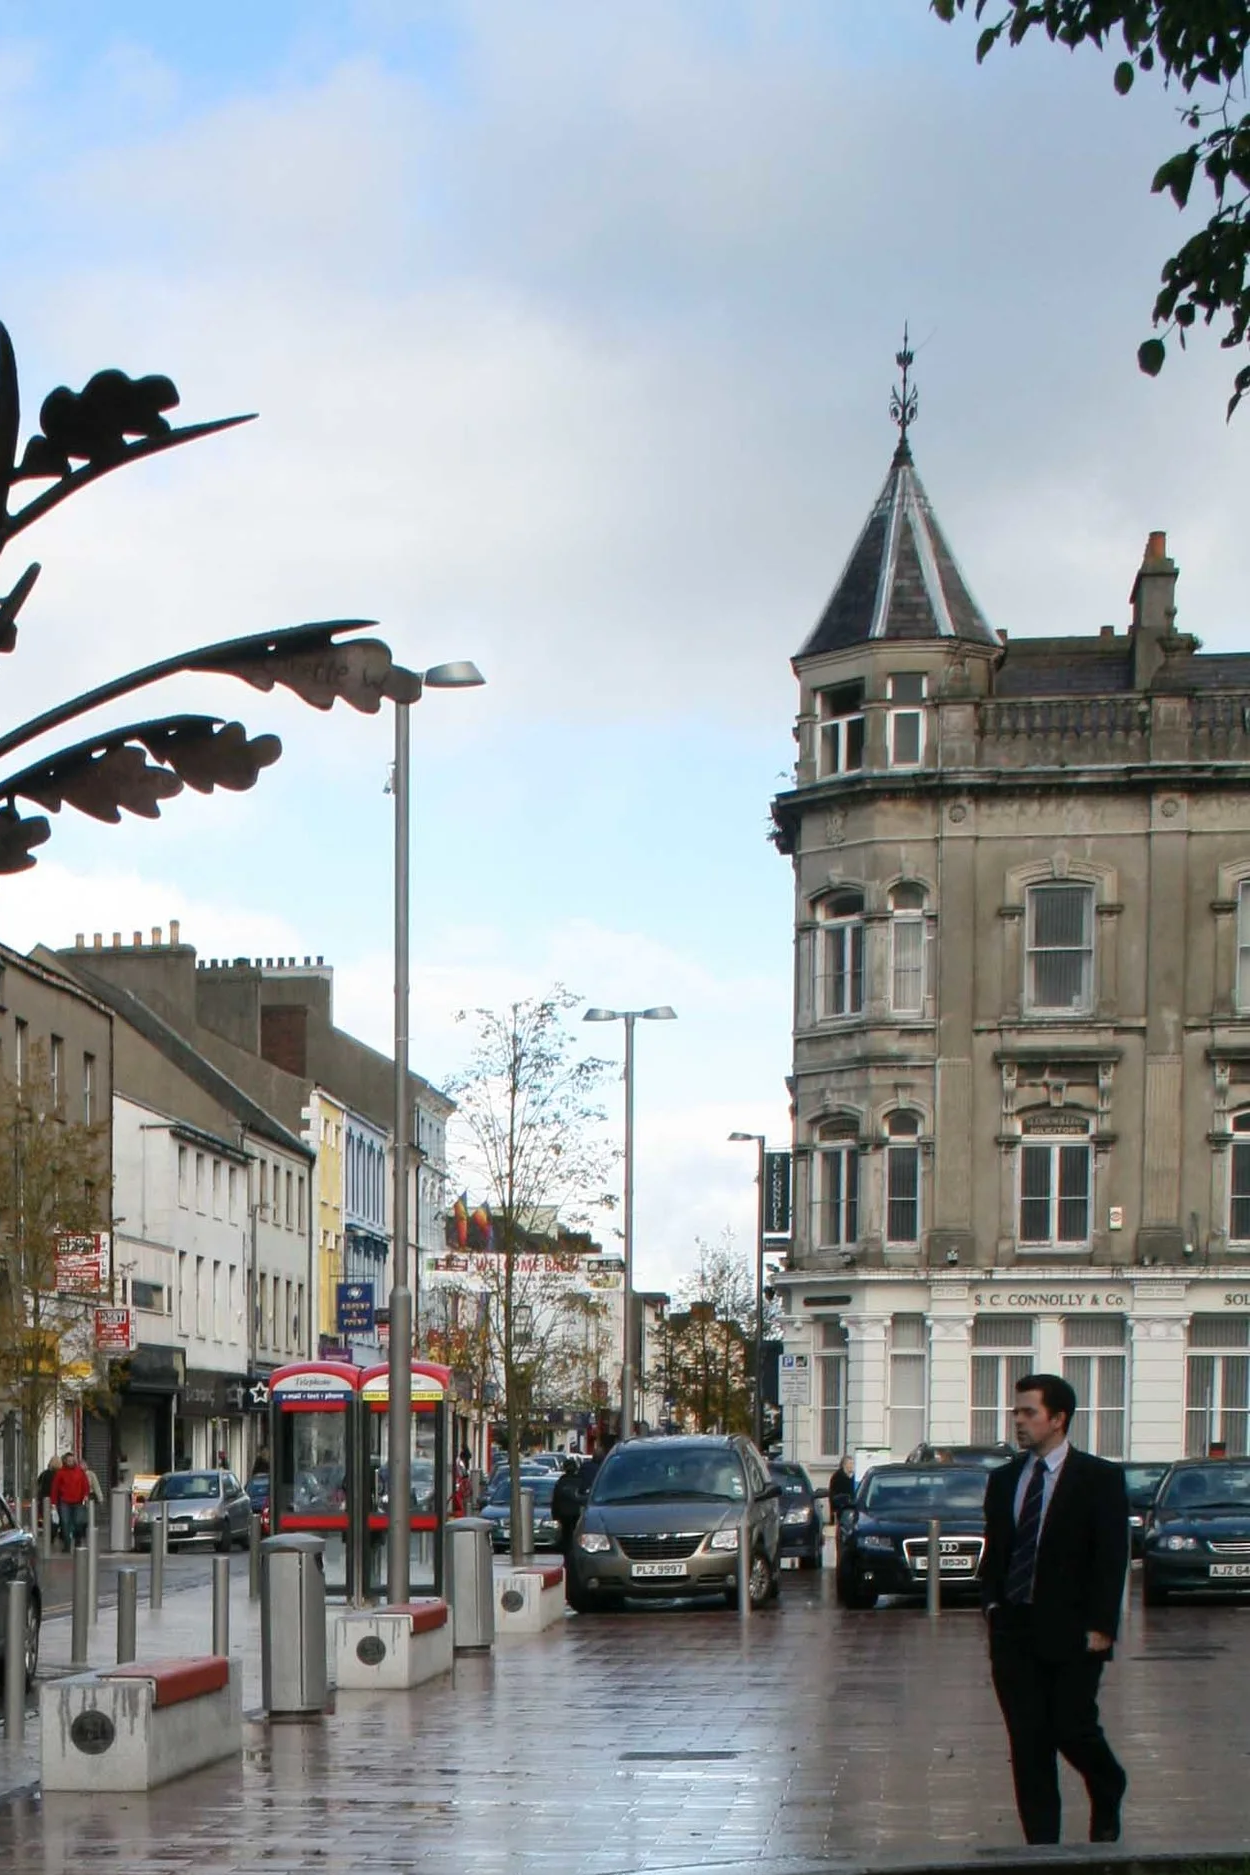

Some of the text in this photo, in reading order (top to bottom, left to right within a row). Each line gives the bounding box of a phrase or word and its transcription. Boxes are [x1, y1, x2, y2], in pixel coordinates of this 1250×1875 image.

[1008, 1294, 1085, 1306] CONNOLLY
[1091, 1294, 1100, 1306] &
[1105, 1294, 1126, 1306] Co.
